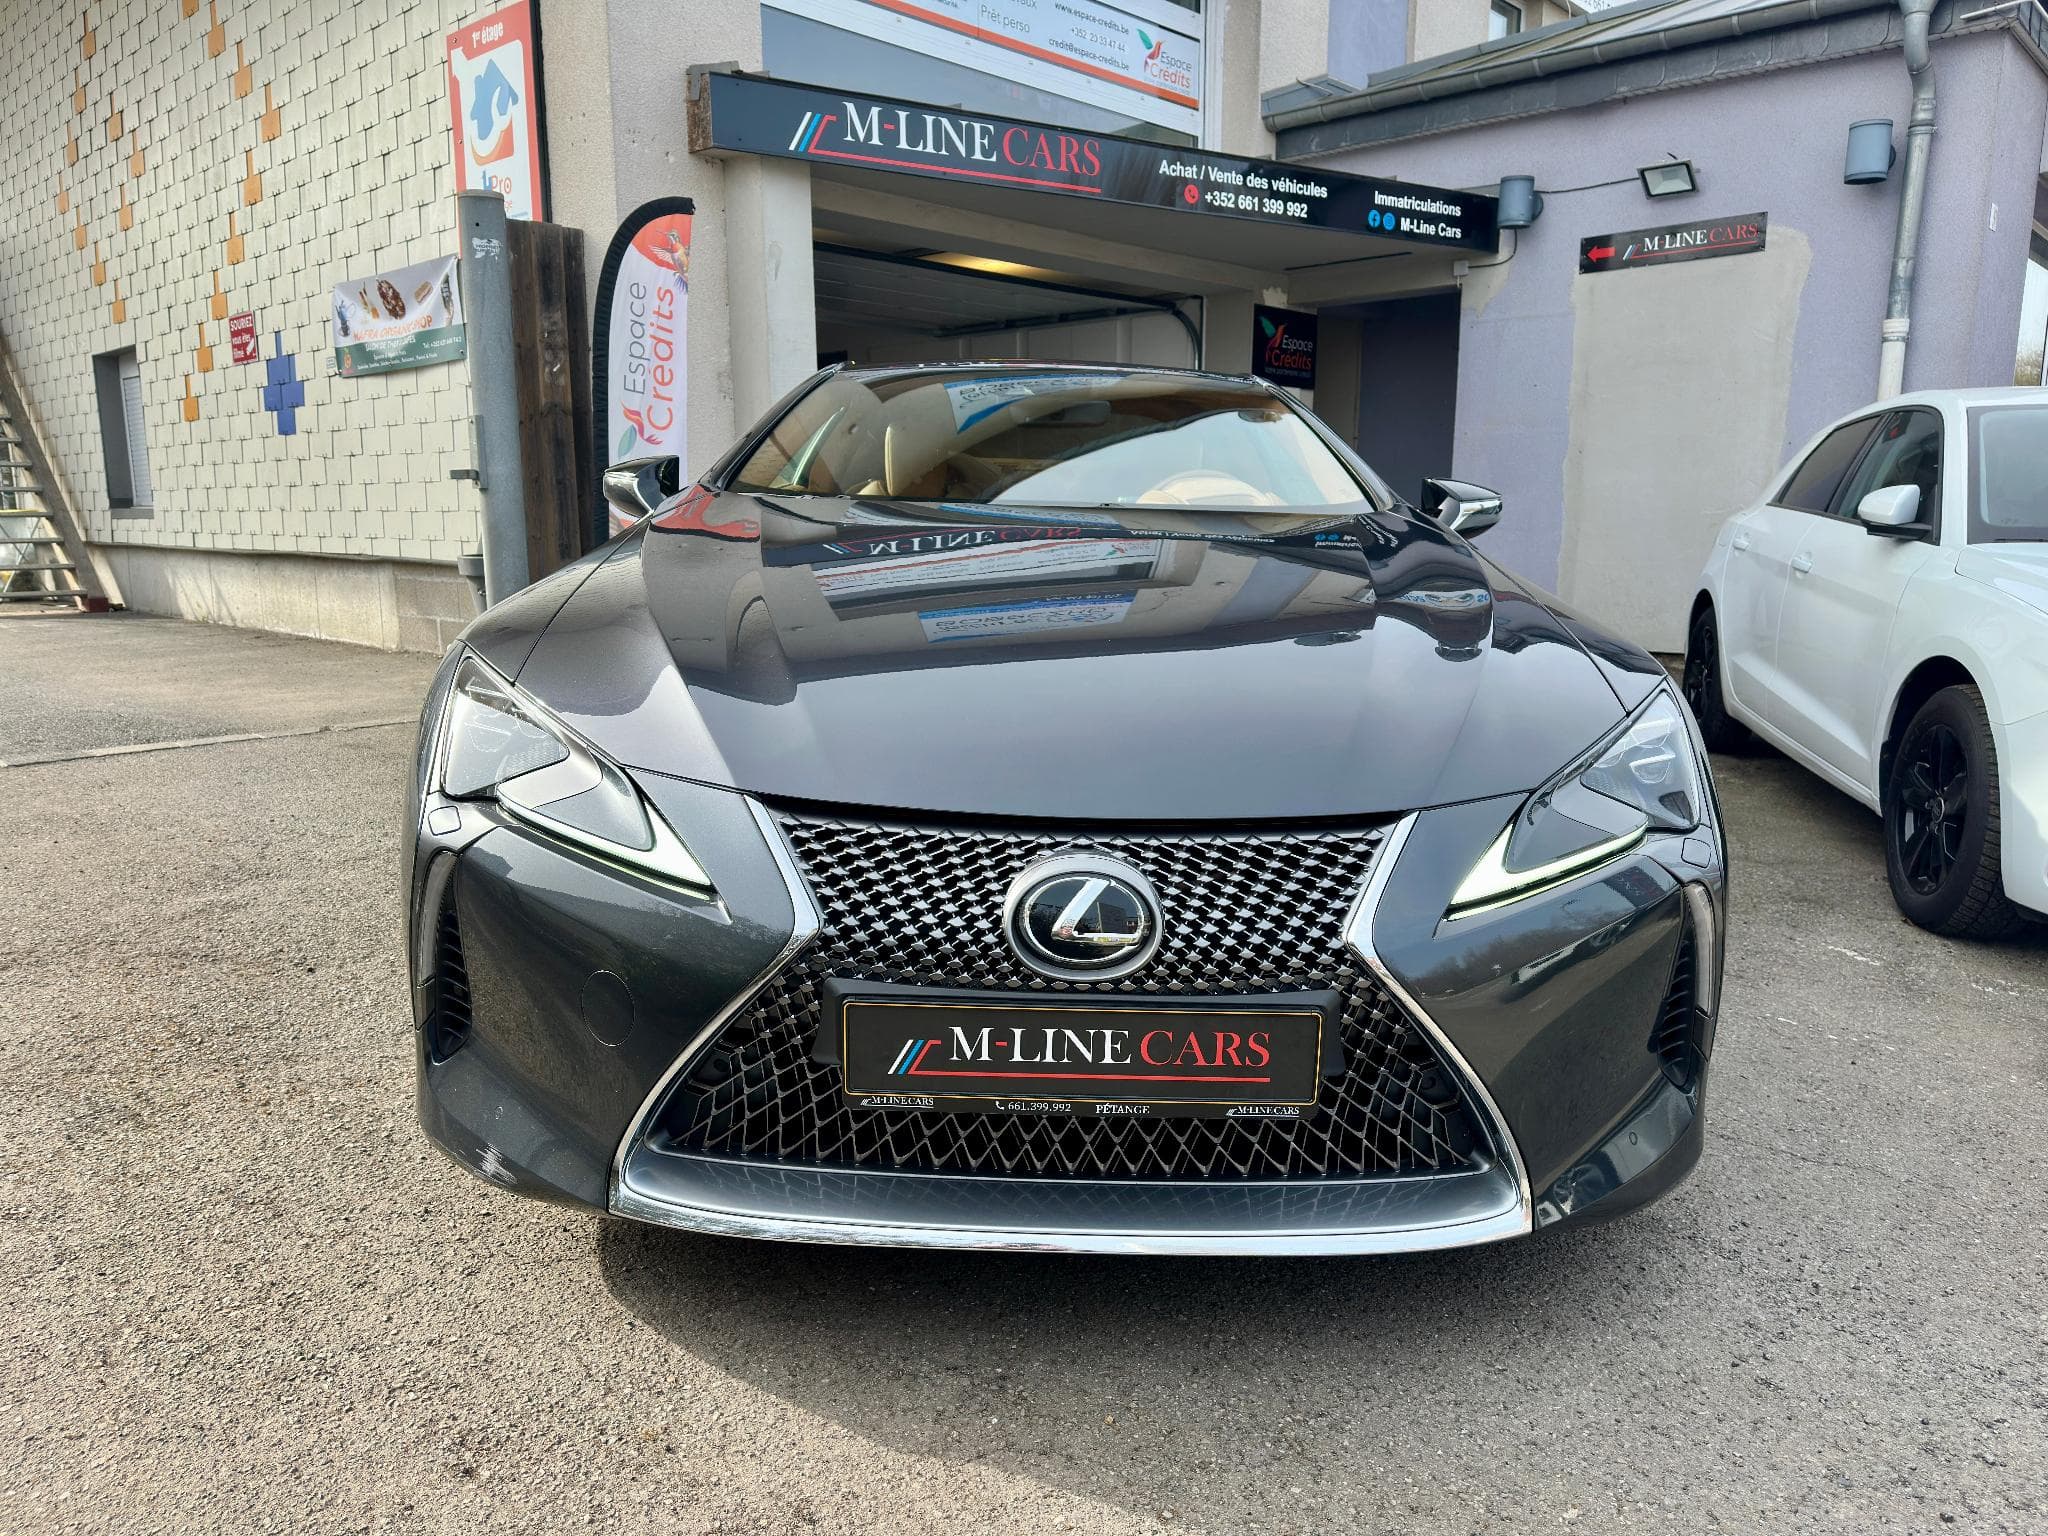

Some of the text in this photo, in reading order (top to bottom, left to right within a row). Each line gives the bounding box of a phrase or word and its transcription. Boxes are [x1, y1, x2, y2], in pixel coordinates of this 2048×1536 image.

[981, 4, 1001, 24] Prêt
[1003, 15, 1030, 34] perso
[472, 21, 504, 49] 1er étage
[1150, 62, 1191, 88] Crédits
[1160, 51, 1192, 72] Espace
[842, 101, 1101, 177] M-LINE CARS
[1159, 159, 1199, 179] Achat
[1207, 166, 1243, 187] Vente
[1247, 172, 1269, 190] des
[1271, 176, 1328, 199] véhicules
[1204, 191, 1309, 219] +352 661 399 992
[1374, 190, 1462, 218] Immatriculations
[1400, 217, 1462, 240] M-Line Cars
[1643, 223, 1759, 252] M-LINE CARS
[623, 281, 650, 395] Espace
[1281, 334, 1313, 352] Espace
[948, 1026, 1271, 1067] M-LINE CARS
[1007, 1101, 1072, 1112] 661.399.992
[1095, 1102, 1151, 1114] PÉTANGE
